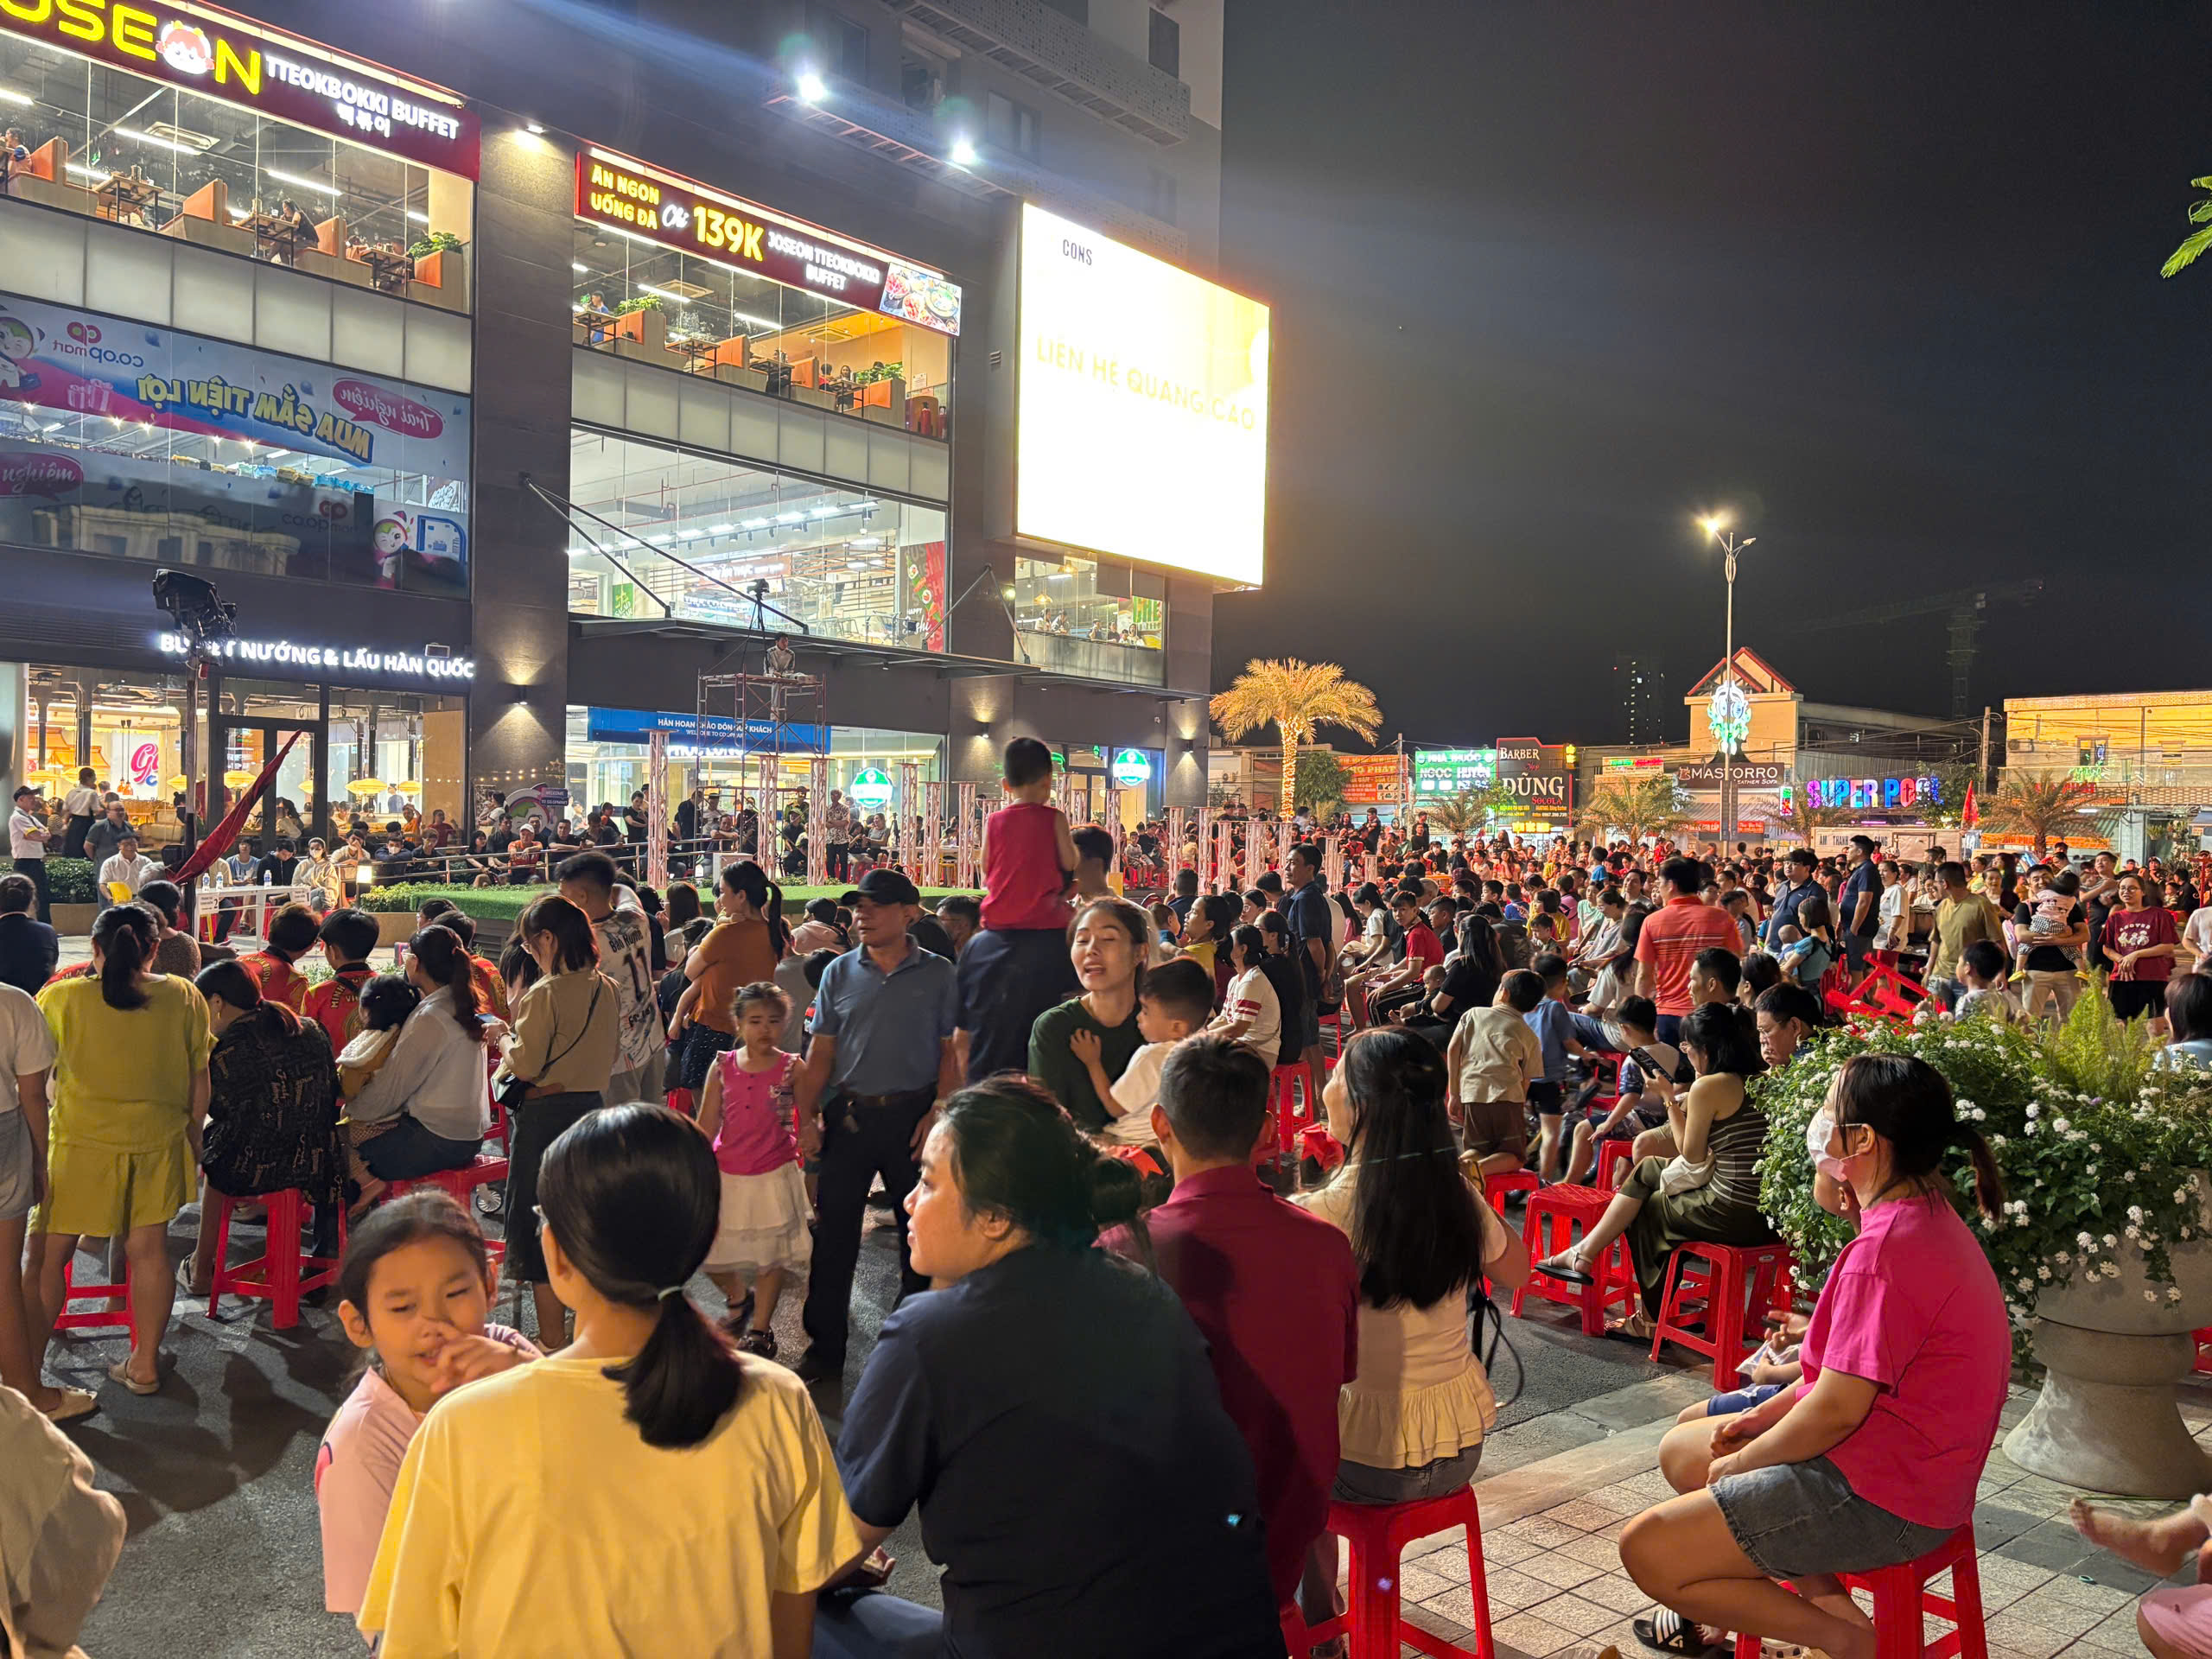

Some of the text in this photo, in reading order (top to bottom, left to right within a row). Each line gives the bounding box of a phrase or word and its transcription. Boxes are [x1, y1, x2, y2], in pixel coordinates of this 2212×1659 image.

[266, 54, 460, 139] TTEOKBOKKI BUFFET
[617, 175, 660, 206] NGON
[591, 193, 635, 222] UỐNG
[693, 206, 765, 262] 139K
[767, 230, 814, 261] JOSEON
[805, 264, 847, 290] BUFFET
[240, 641, 321, 665] NƯỚNG
[323, 649, 339, 666] &
[384, 652, 423, 673] HÀN
[426, 658, 474, 678] QUỐC
[749, 725, 772, 734] KHÁCH
[1500, 747, 1540, 760] BARBER
[1502, 772, 1565, 801] DŨNG
[1691, 766, 1778, 779] MASTORRO
[1807, 779, 1879, 809] SUPER
[213, 898, 219, 909] 2
